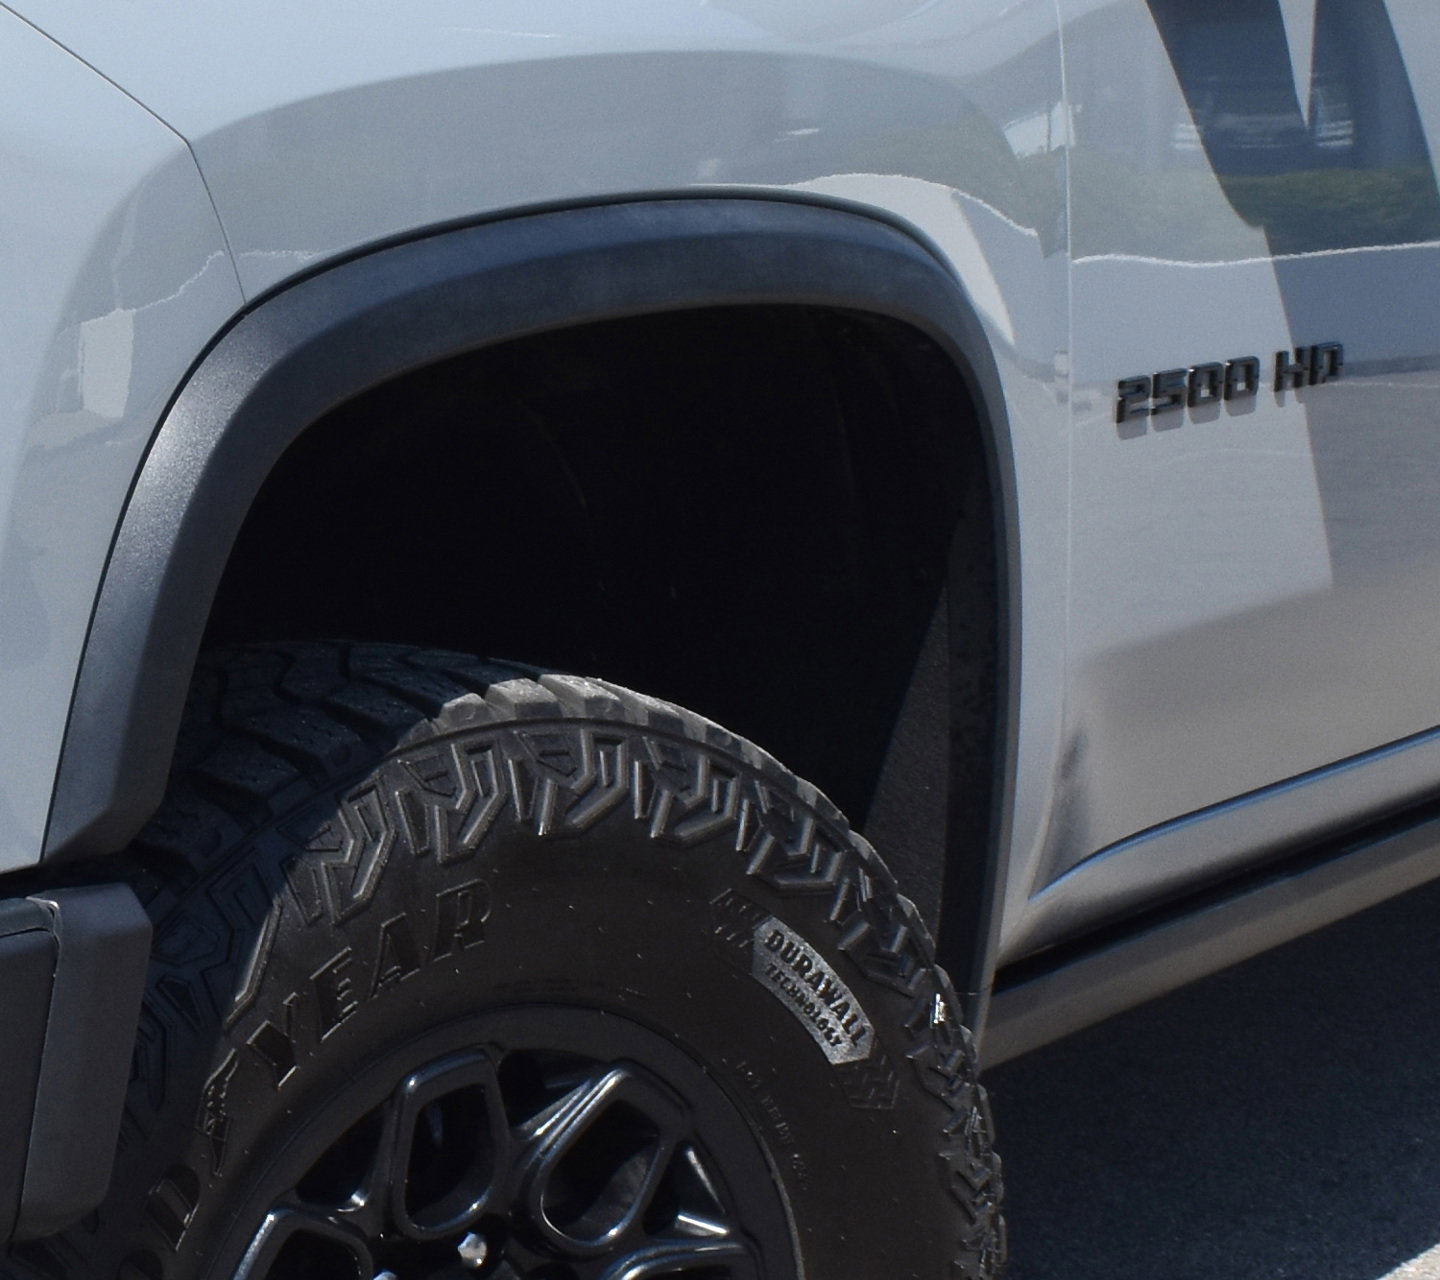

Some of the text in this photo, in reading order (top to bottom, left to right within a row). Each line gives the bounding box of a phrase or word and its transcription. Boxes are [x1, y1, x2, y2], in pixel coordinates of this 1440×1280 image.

[1115, 340, 1344, 424] 2500 HD
[763, 962, 843, 1047] TECHNOLOGY
[764, 929, 866, 1047] DURAWALL
